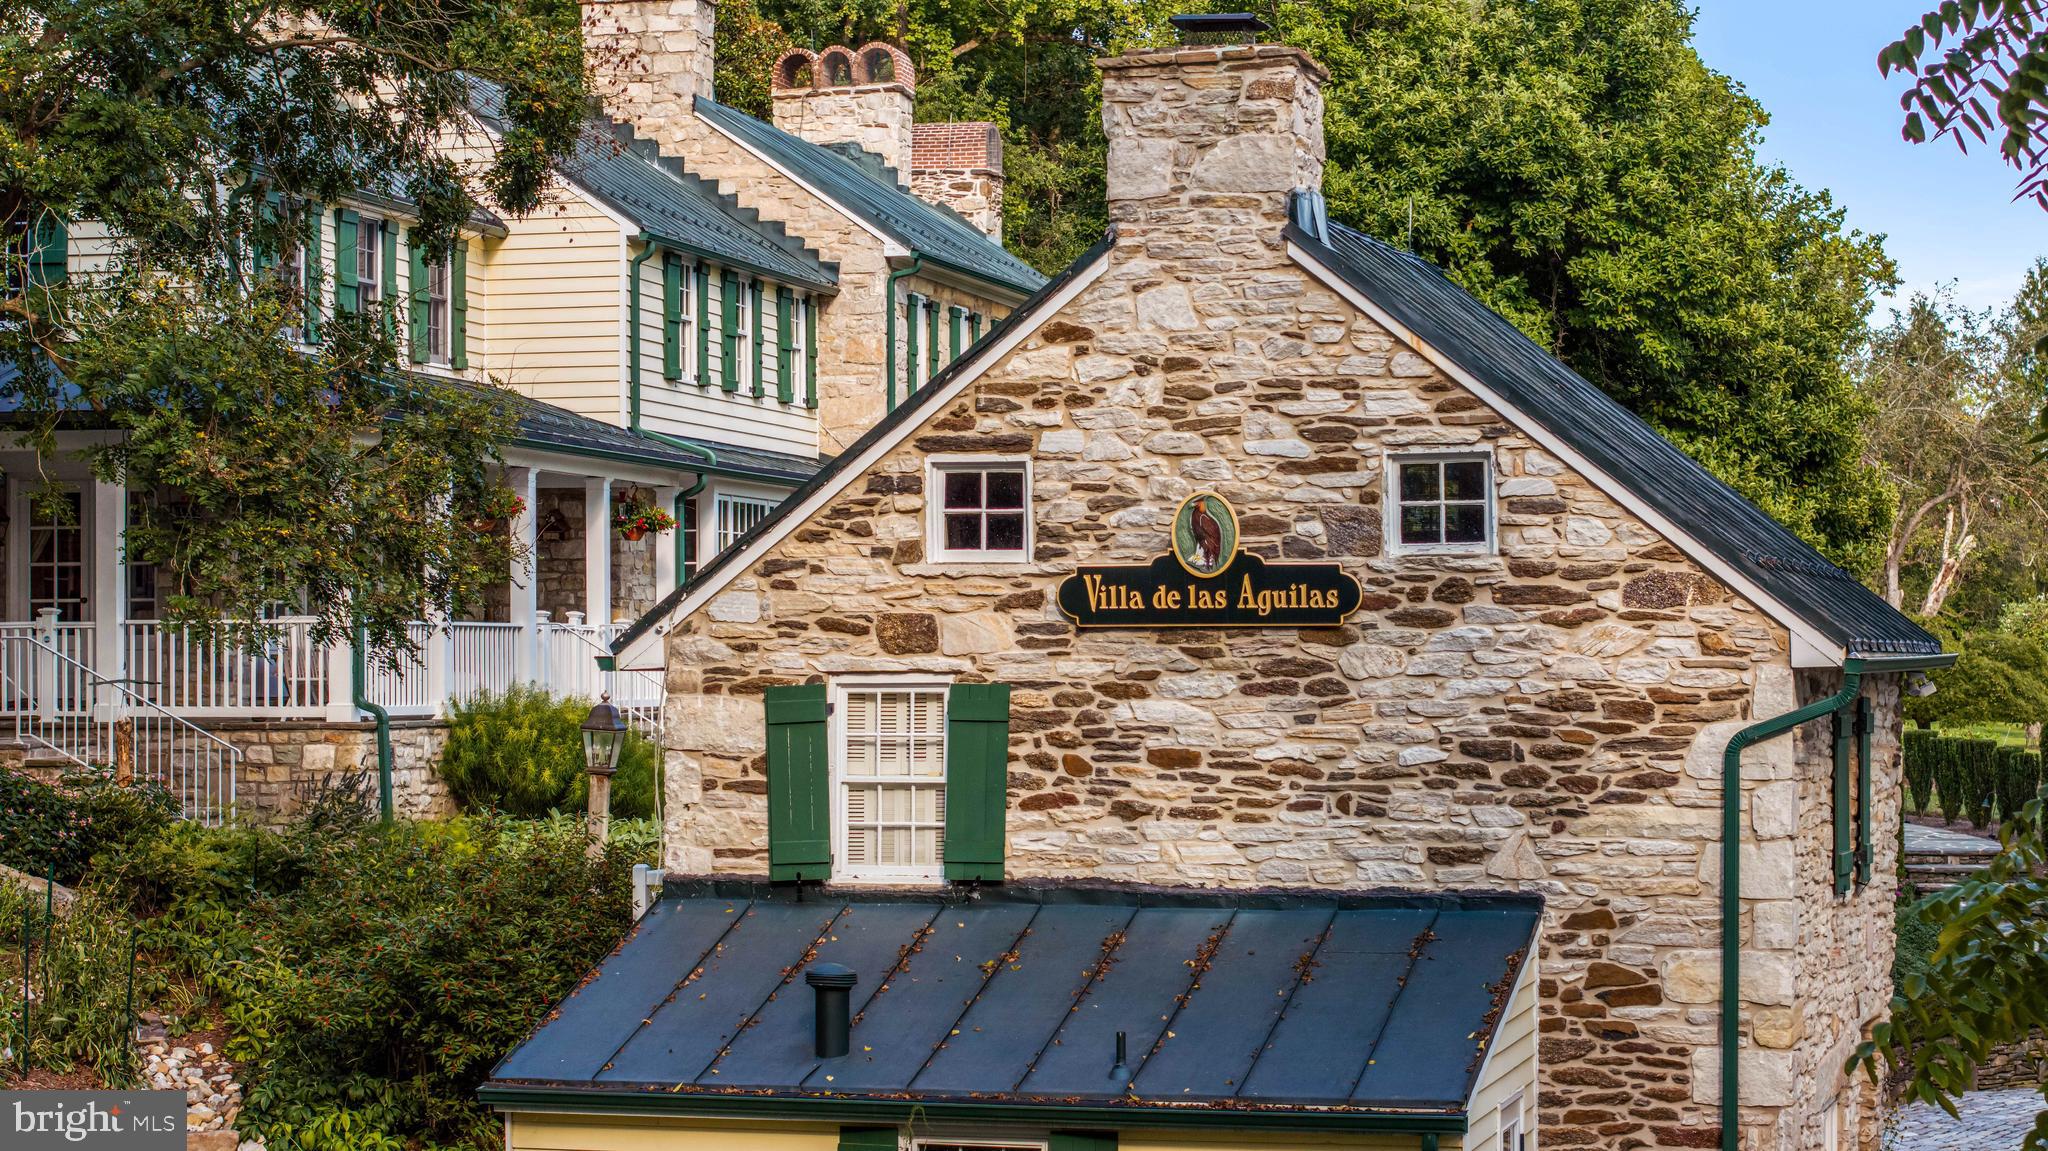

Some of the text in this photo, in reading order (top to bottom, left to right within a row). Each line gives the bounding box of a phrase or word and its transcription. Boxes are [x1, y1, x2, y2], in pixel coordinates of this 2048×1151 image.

[1083, 572, 1339, 616] Villa de las Aguilas
